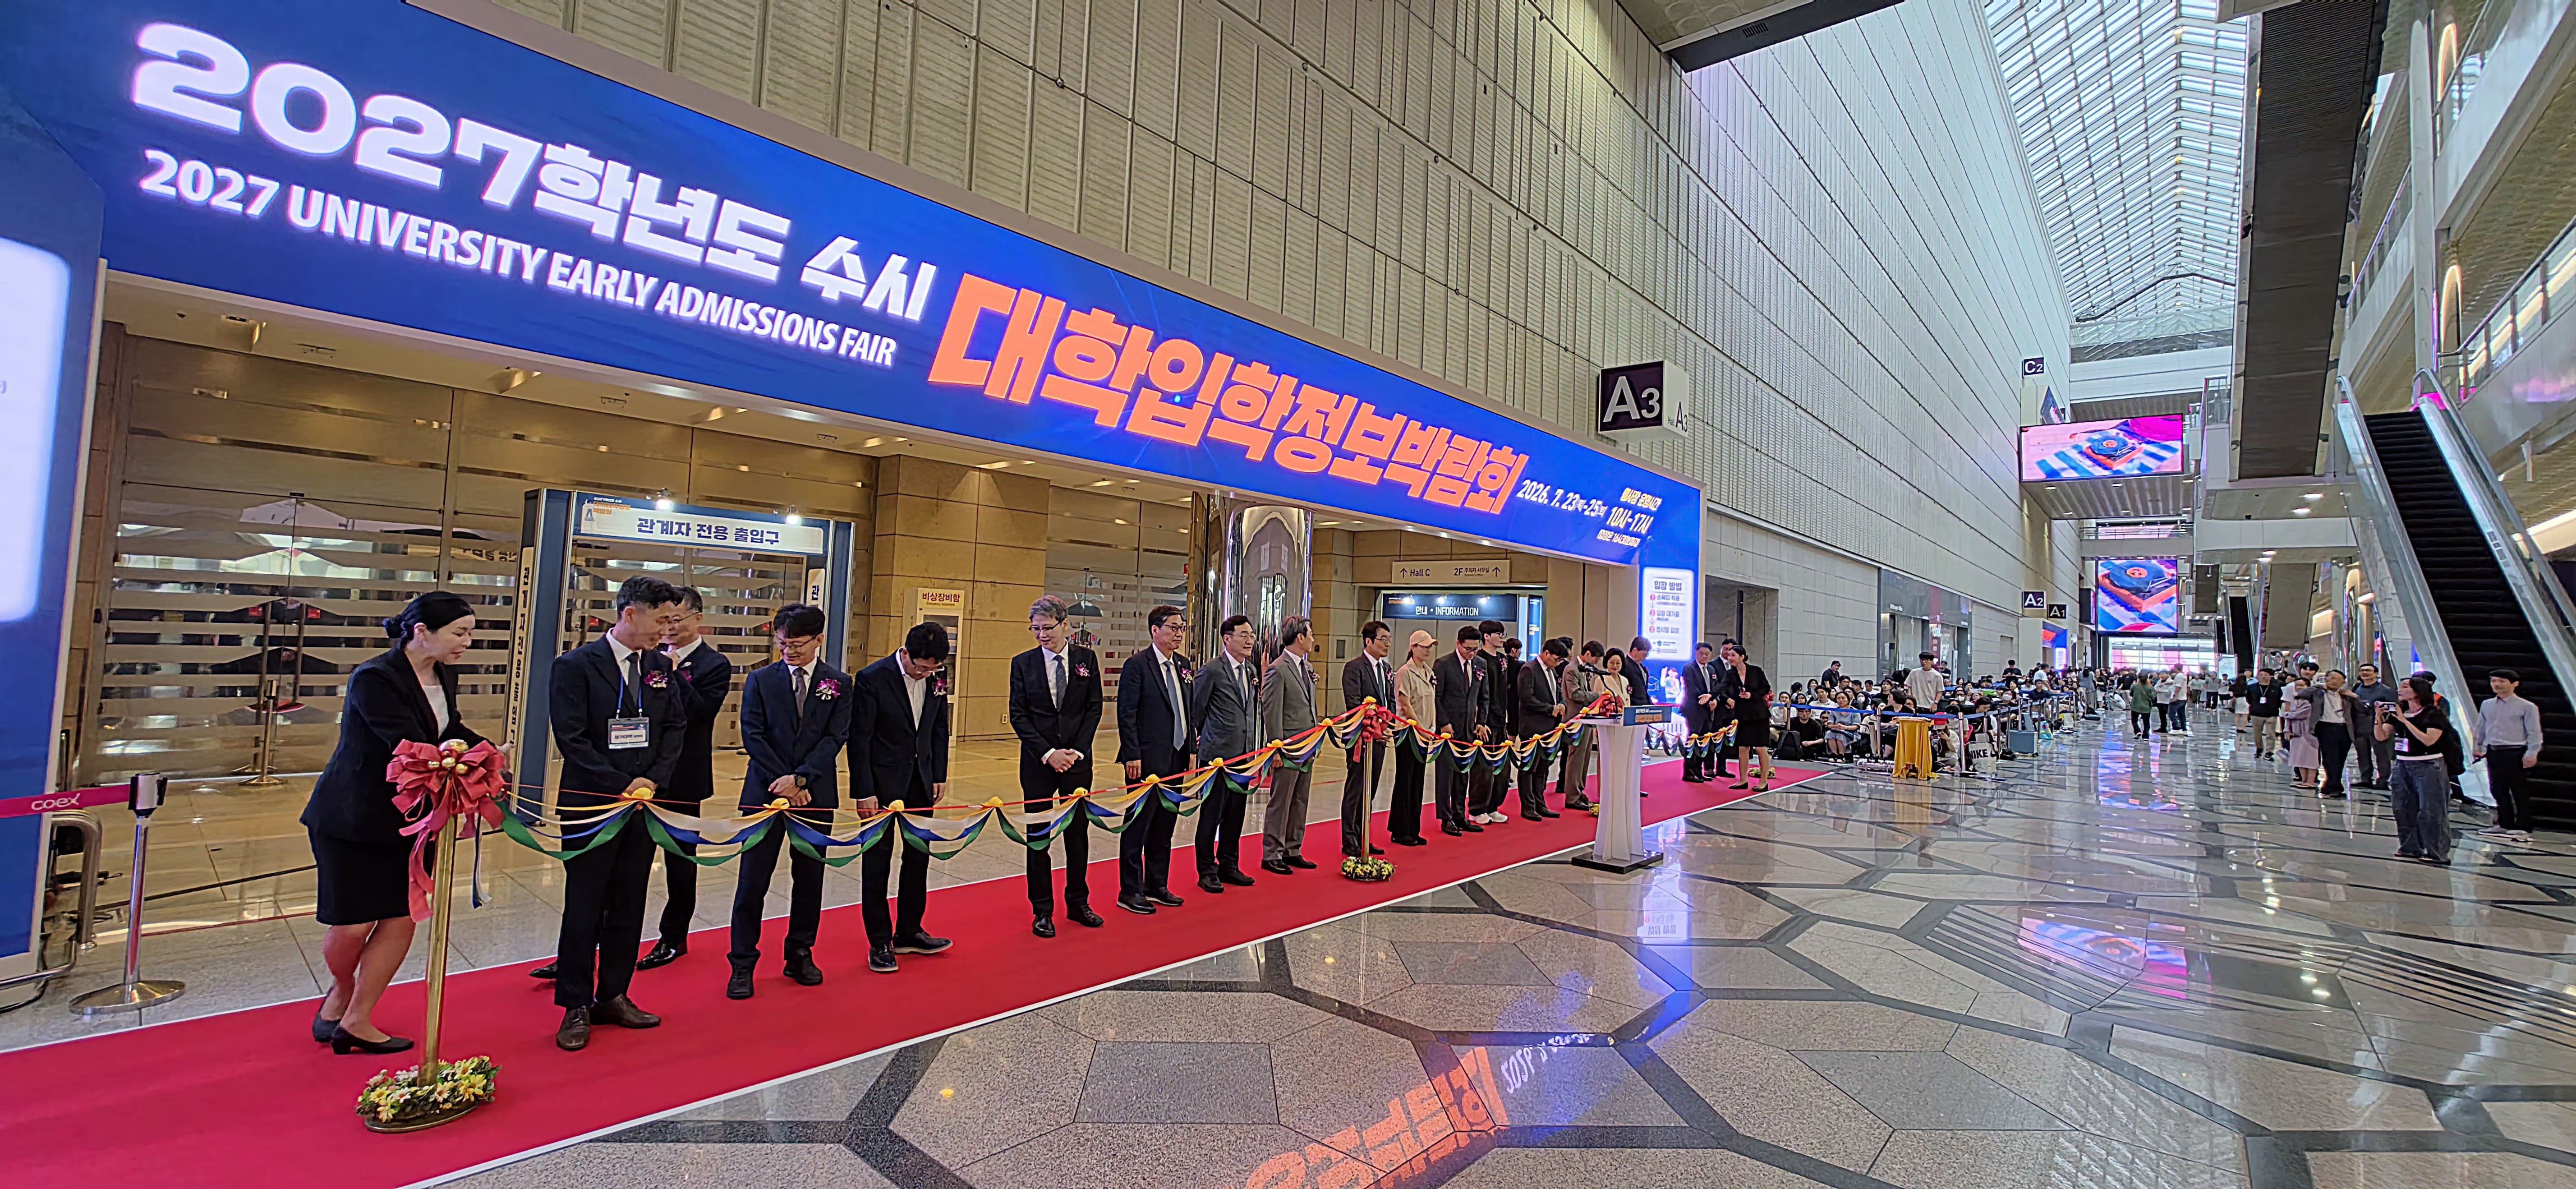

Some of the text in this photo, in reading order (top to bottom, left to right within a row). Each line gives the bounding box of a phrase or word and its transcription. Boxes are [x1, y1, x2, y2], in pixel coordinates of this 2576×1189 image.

[132, 22, 937, 321] 2027학년도 수시
[139, 149, 897, 367] 2027 UNIVERSITY EARLY ADMISSIONS FAIR
[2025, 361, 2043, 373] C2
[928, 273, 1529, 514] 대학입학정보박람회
[1603, 376, 1660, 423] A3
[1676, 401, 1688, 432] A3
[1516, 479, 1550, 504] 2026.
[1550, 489, 1564, 507] 7.
[637, 517, 779, 545] 관계자 전용 출입구
[1454, 568, 1463, 576] 2F
[1654, 581, 1682, 591] 입장 방법
[922, 592, 960, 603] 비상장비함
[2024, 593, 2043, 606] A2
[1435, 606, 1479, 616] INFORMATION
[2050, 606, 2065, 617] A1
[1968, 749, 1988, 759] NIKE
[32, 793, 80, 810] coex
